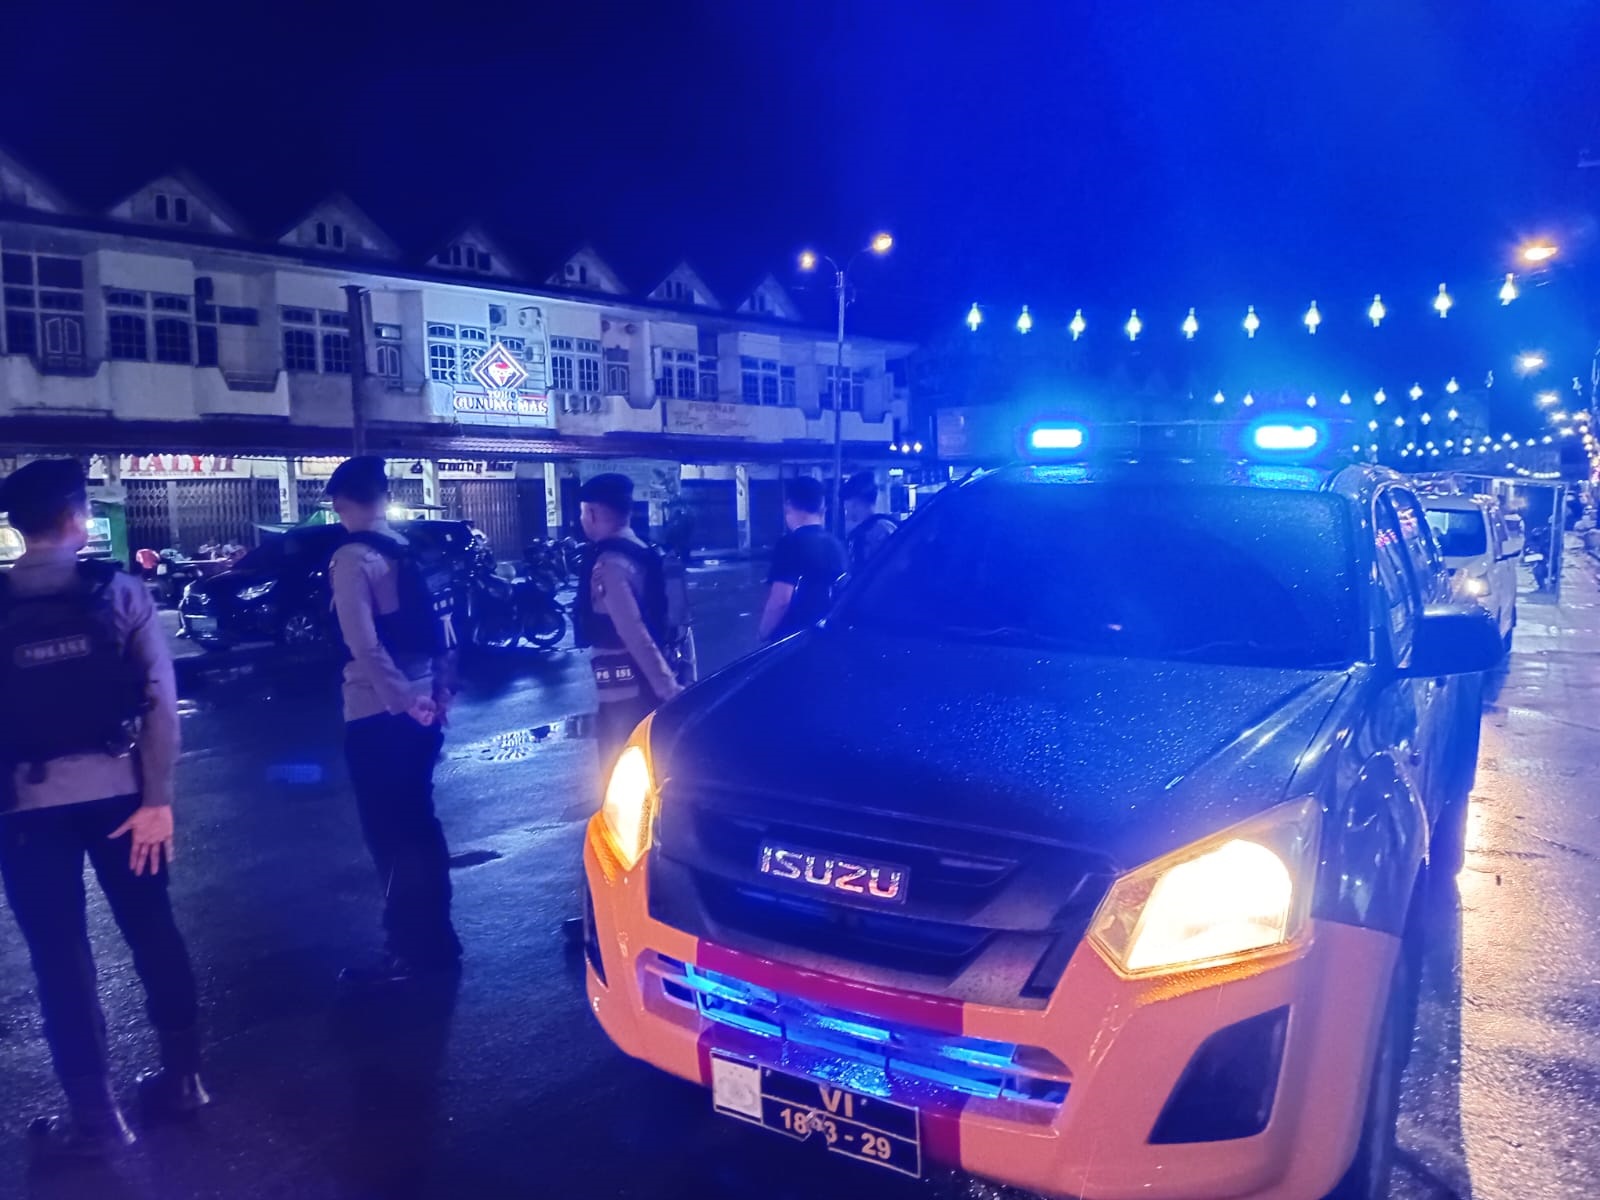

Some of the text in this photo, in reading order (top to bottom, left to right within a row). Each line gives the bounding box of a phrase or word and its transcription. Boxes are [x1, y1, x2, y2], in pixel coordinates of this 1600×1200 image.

[453, 395, 549, 415] GUNUNG MAS
[760, 846, 901, 898] ISUZU
[819, 1085, 854, 1117] VI
[861, 1132, 892, 1160] 29
